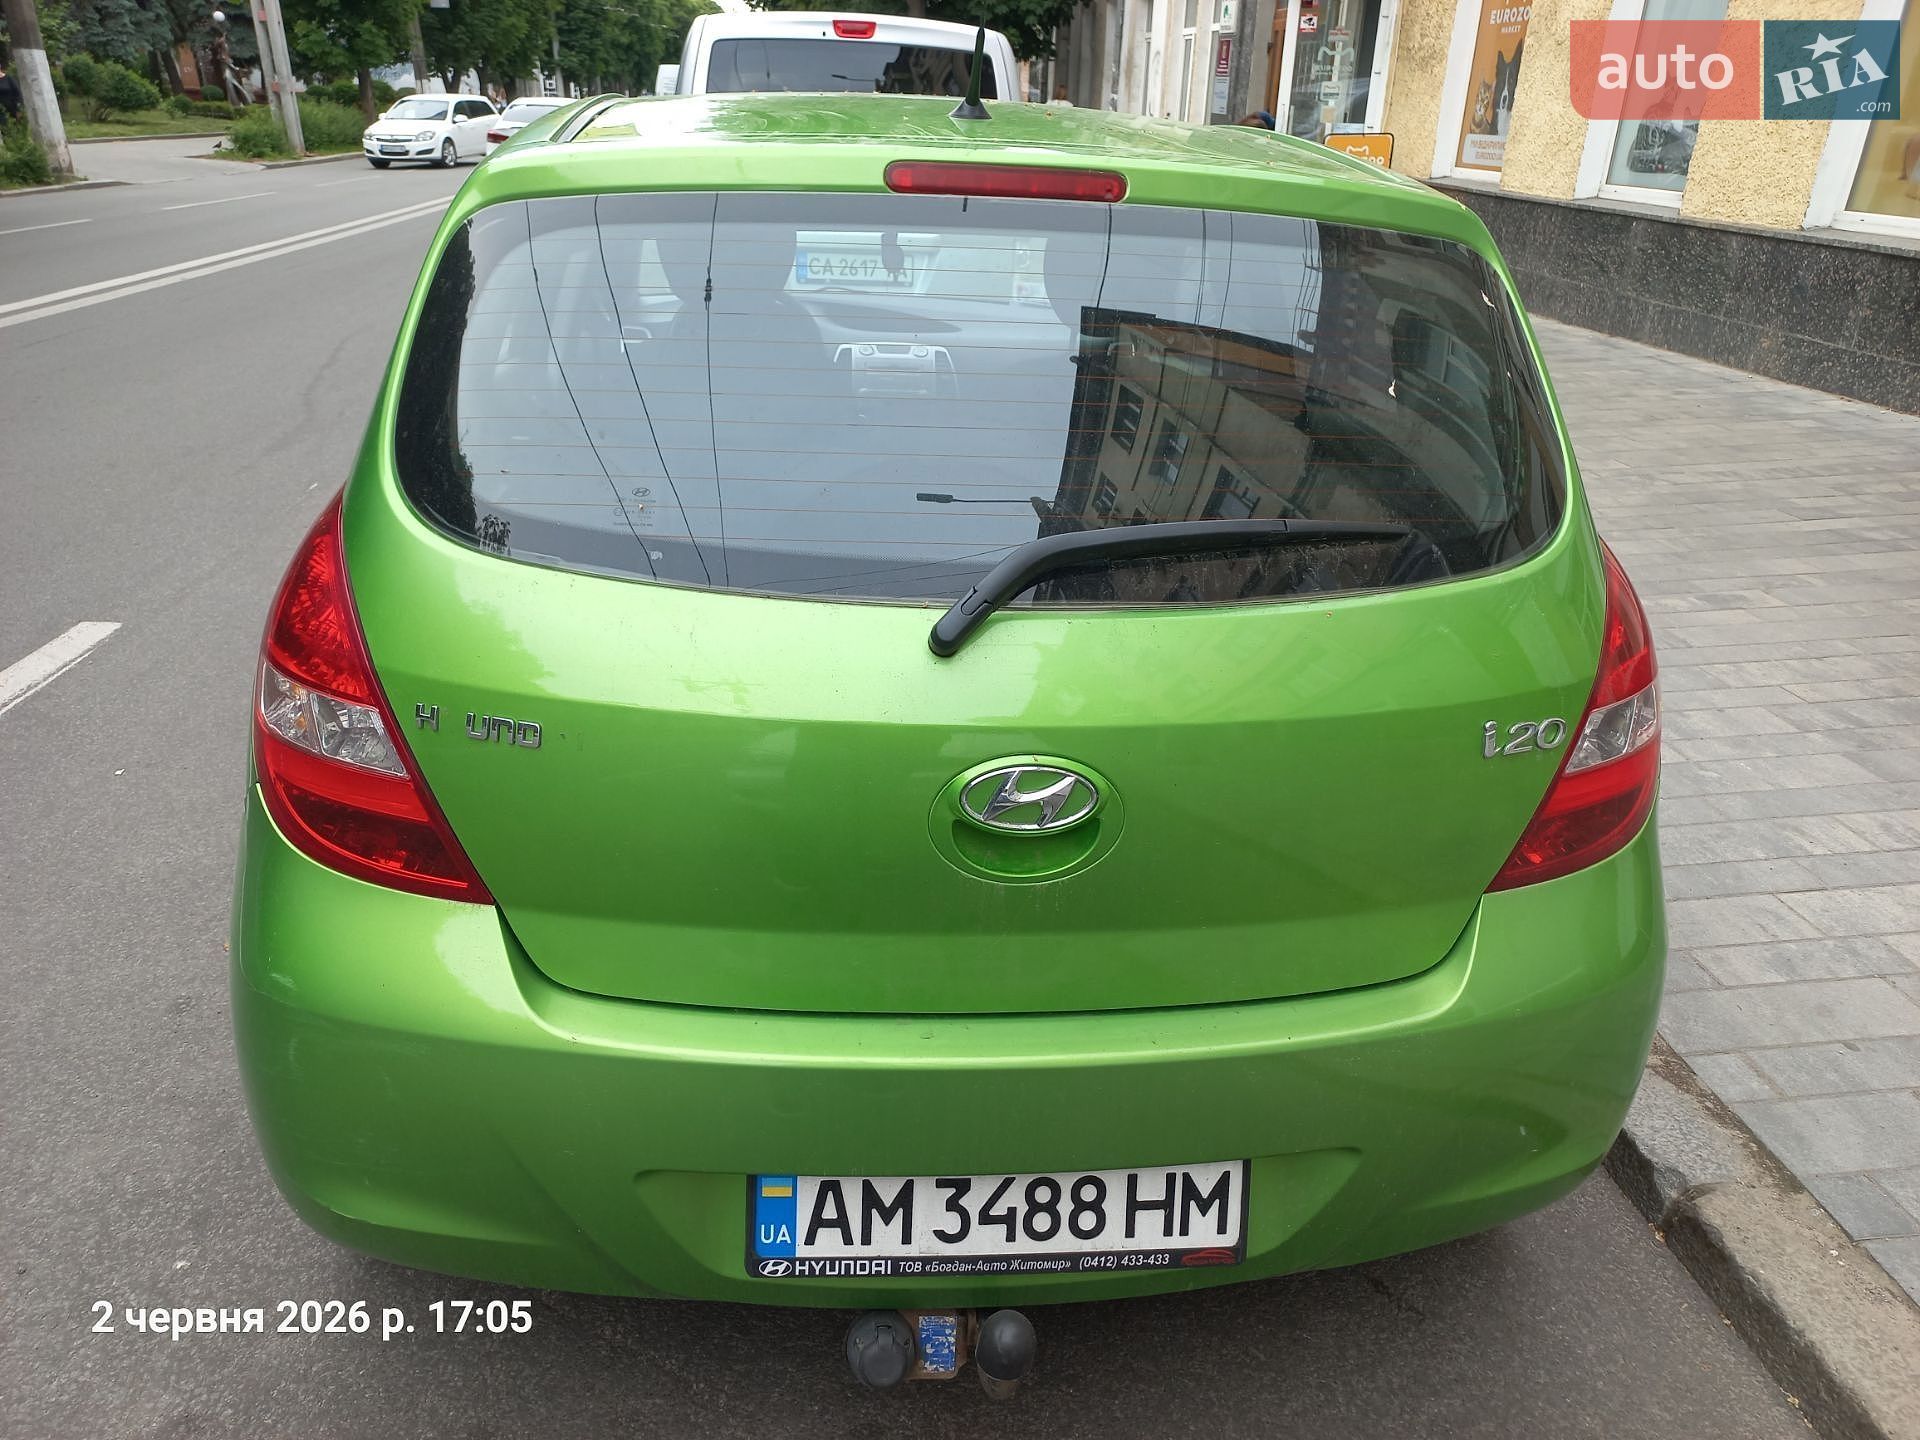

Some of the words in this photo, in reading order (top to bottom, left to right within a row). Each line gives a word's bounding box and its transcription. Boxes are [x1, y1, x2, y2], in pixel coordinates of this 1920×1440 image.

[839, 258, 879, 278] 2617
[1483, 717, 1567, 759] i20
[803, 1178, 914, 1246] AM
[932, 1174, 1107, 1244] 3488
[1124, 1170, 1231, 1239] HM
[760, 1224, 791, 1244] UA
[795, 1259, 892, 1276] HYUNDAI
[899, 1261, 922, 1273] ТОВ
[1079, 1255, 1118, 1271] (0412)
[1121, 1253, 1170, 1267] 433-433
